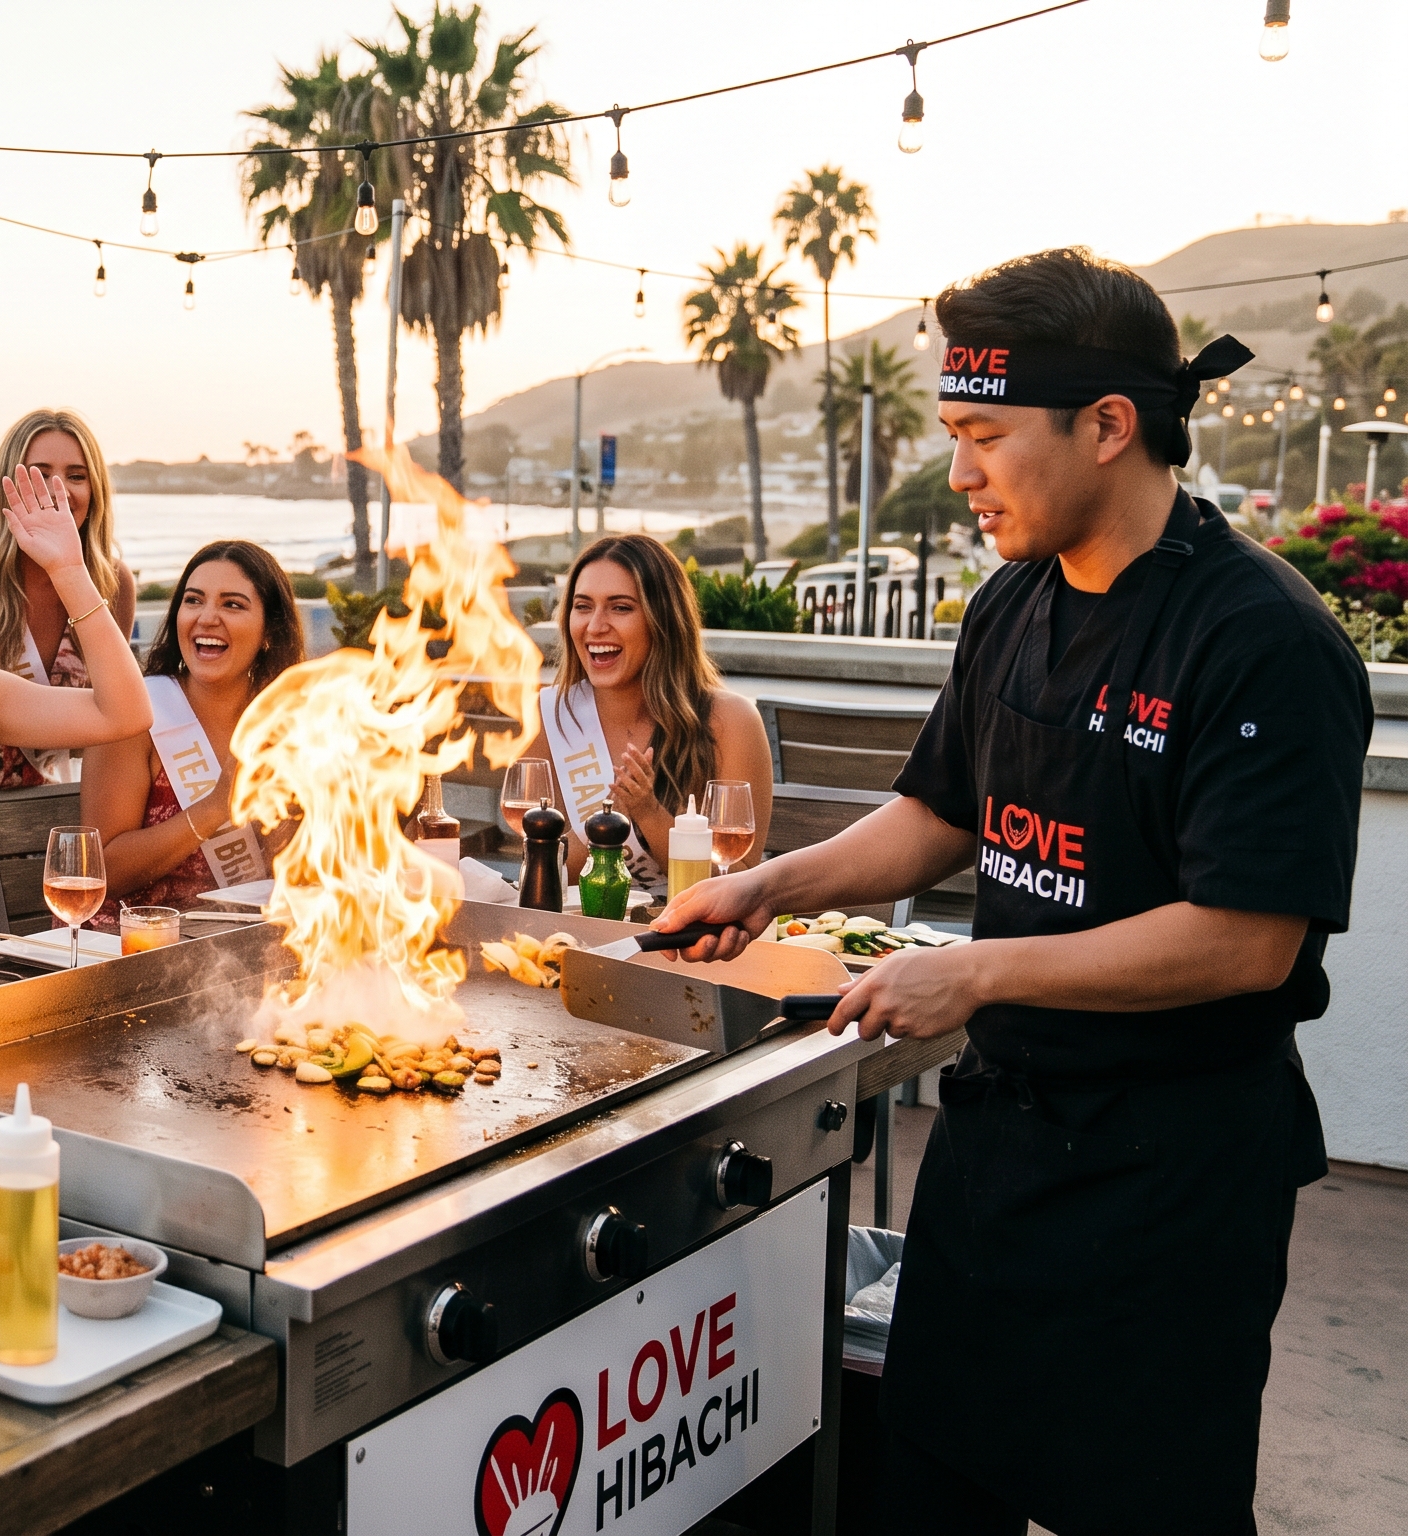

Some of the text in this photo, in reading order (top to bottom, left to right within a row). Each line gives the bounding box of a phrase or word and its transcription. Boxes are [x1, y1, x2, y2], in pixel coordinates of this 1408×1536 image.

[939, 375, 1007, 397] HIBACHI
[942, 346, 1010, 375] LOVE
[1088, 712, 1166, 754] HACHI
[983, 796, 1085, 871] LOVE
[980, 845, 1085, 908] HIBACHI
[597, 1291, 737, 1452] LOVE
[595, 1368, 760, 1533] HIBACHI
